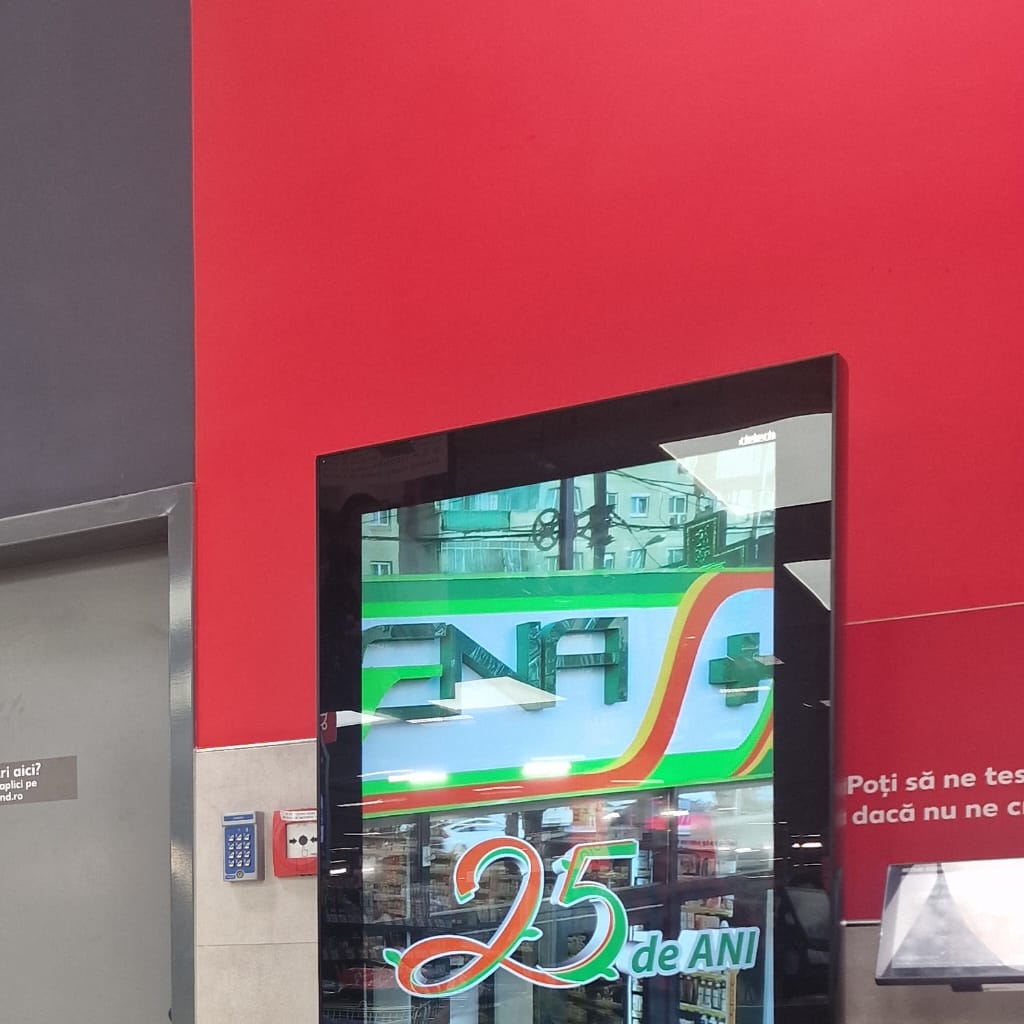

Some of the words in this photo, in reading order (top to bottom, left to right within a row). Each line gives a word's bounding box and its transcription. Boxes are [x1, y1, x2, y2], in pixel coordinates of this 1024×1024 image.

[13, 762, 42, 778] aici?
[0, 779, 24, 792] aplici
[25, 779, 38, 791] pe
[847, 773, 898, 798] Poți
[905, 770, 936, 792] să
[943, 772, 976, 789] ne
[852, 803, 916, 825] dacă
[923, 805, 957, 821] nu
[965, 802, 999, 818] ne
[1006, 800, 1024, 816] c
[382, 836, 641, 999] 25
[631, 934, 680, 974] de
[687, 931, 757, 969] ANI
